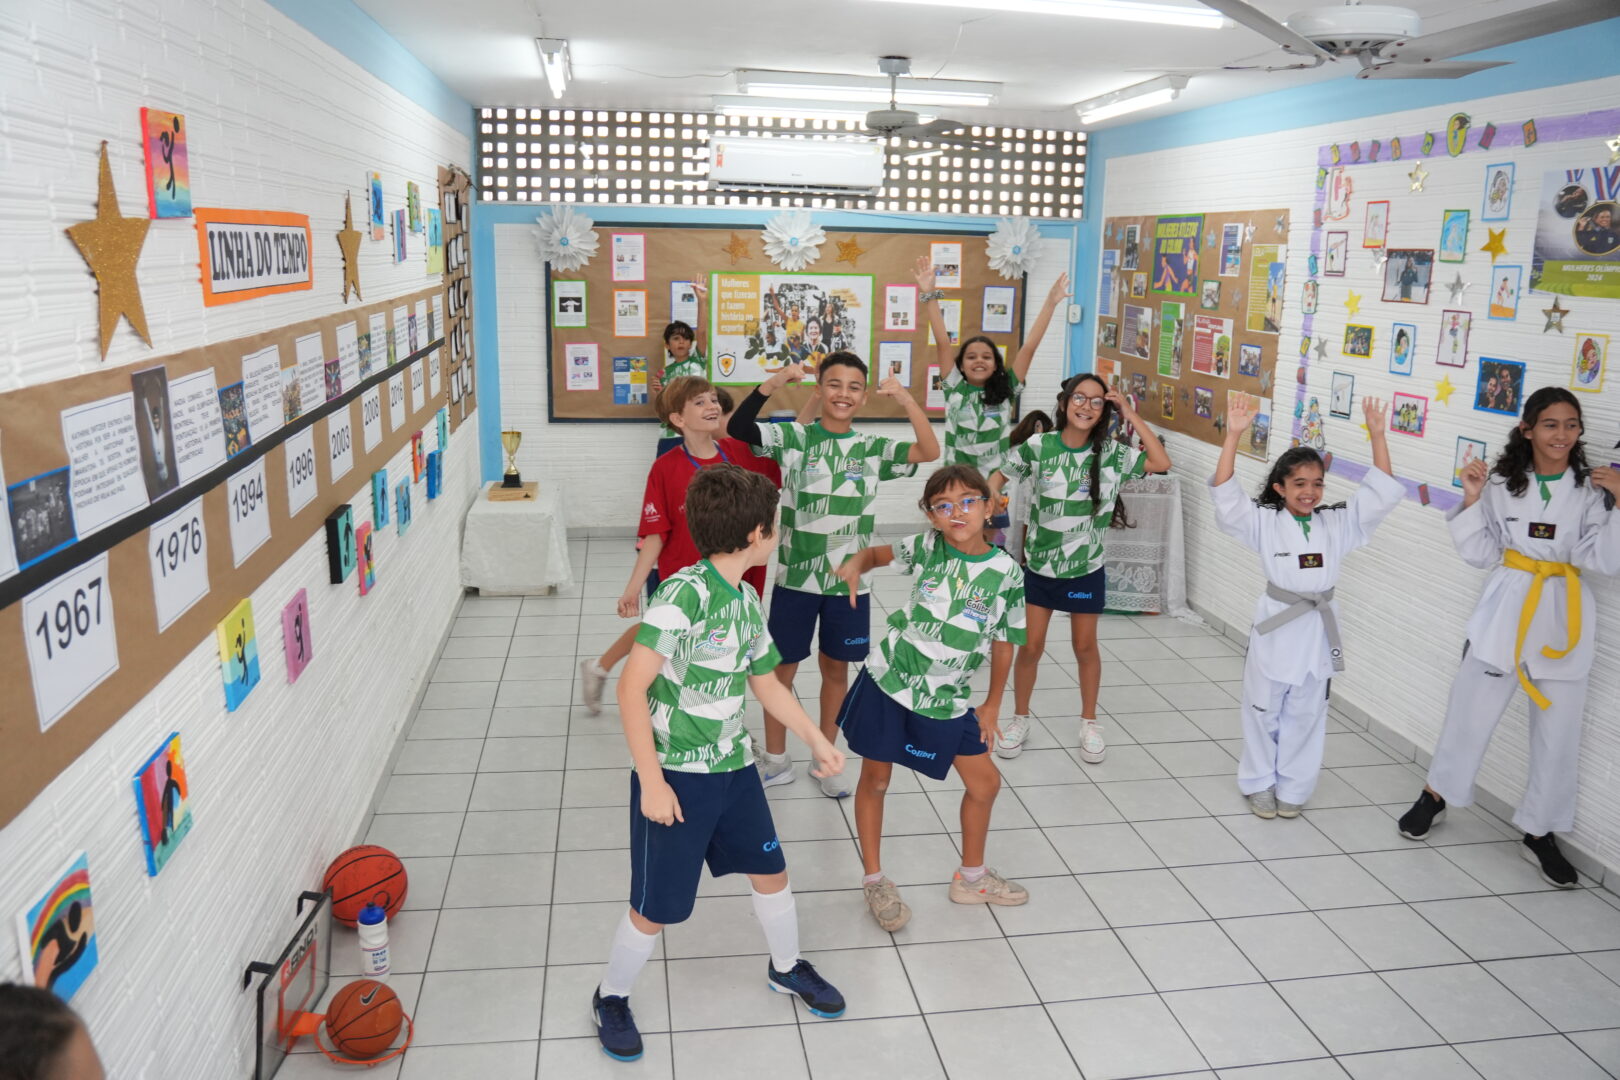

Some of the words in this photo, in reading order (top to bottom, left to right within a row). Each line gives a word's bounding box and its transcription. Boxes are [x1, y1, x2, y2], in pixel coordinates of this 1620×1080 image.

[209, 230, 254, 280] LINHA
[255, 232, 272, 276] DO
[274, 232, 307, 275] TEMPO
[364, 396, 380, 425] 2008
[391, 381, 403, 407] 2016
[332, 426, 350, 460] 2003
[290, 448, 314, 488] 1996
[232, 472, 264, 522] 1994
[156, 516, 202, 578] 1976
[966, 599, 990, 614] Colibri
[1068, 592, 1092, 600] Colibri
[36, 576, 102, 660] 1967
[905, 744, 936, 760] Colibri
